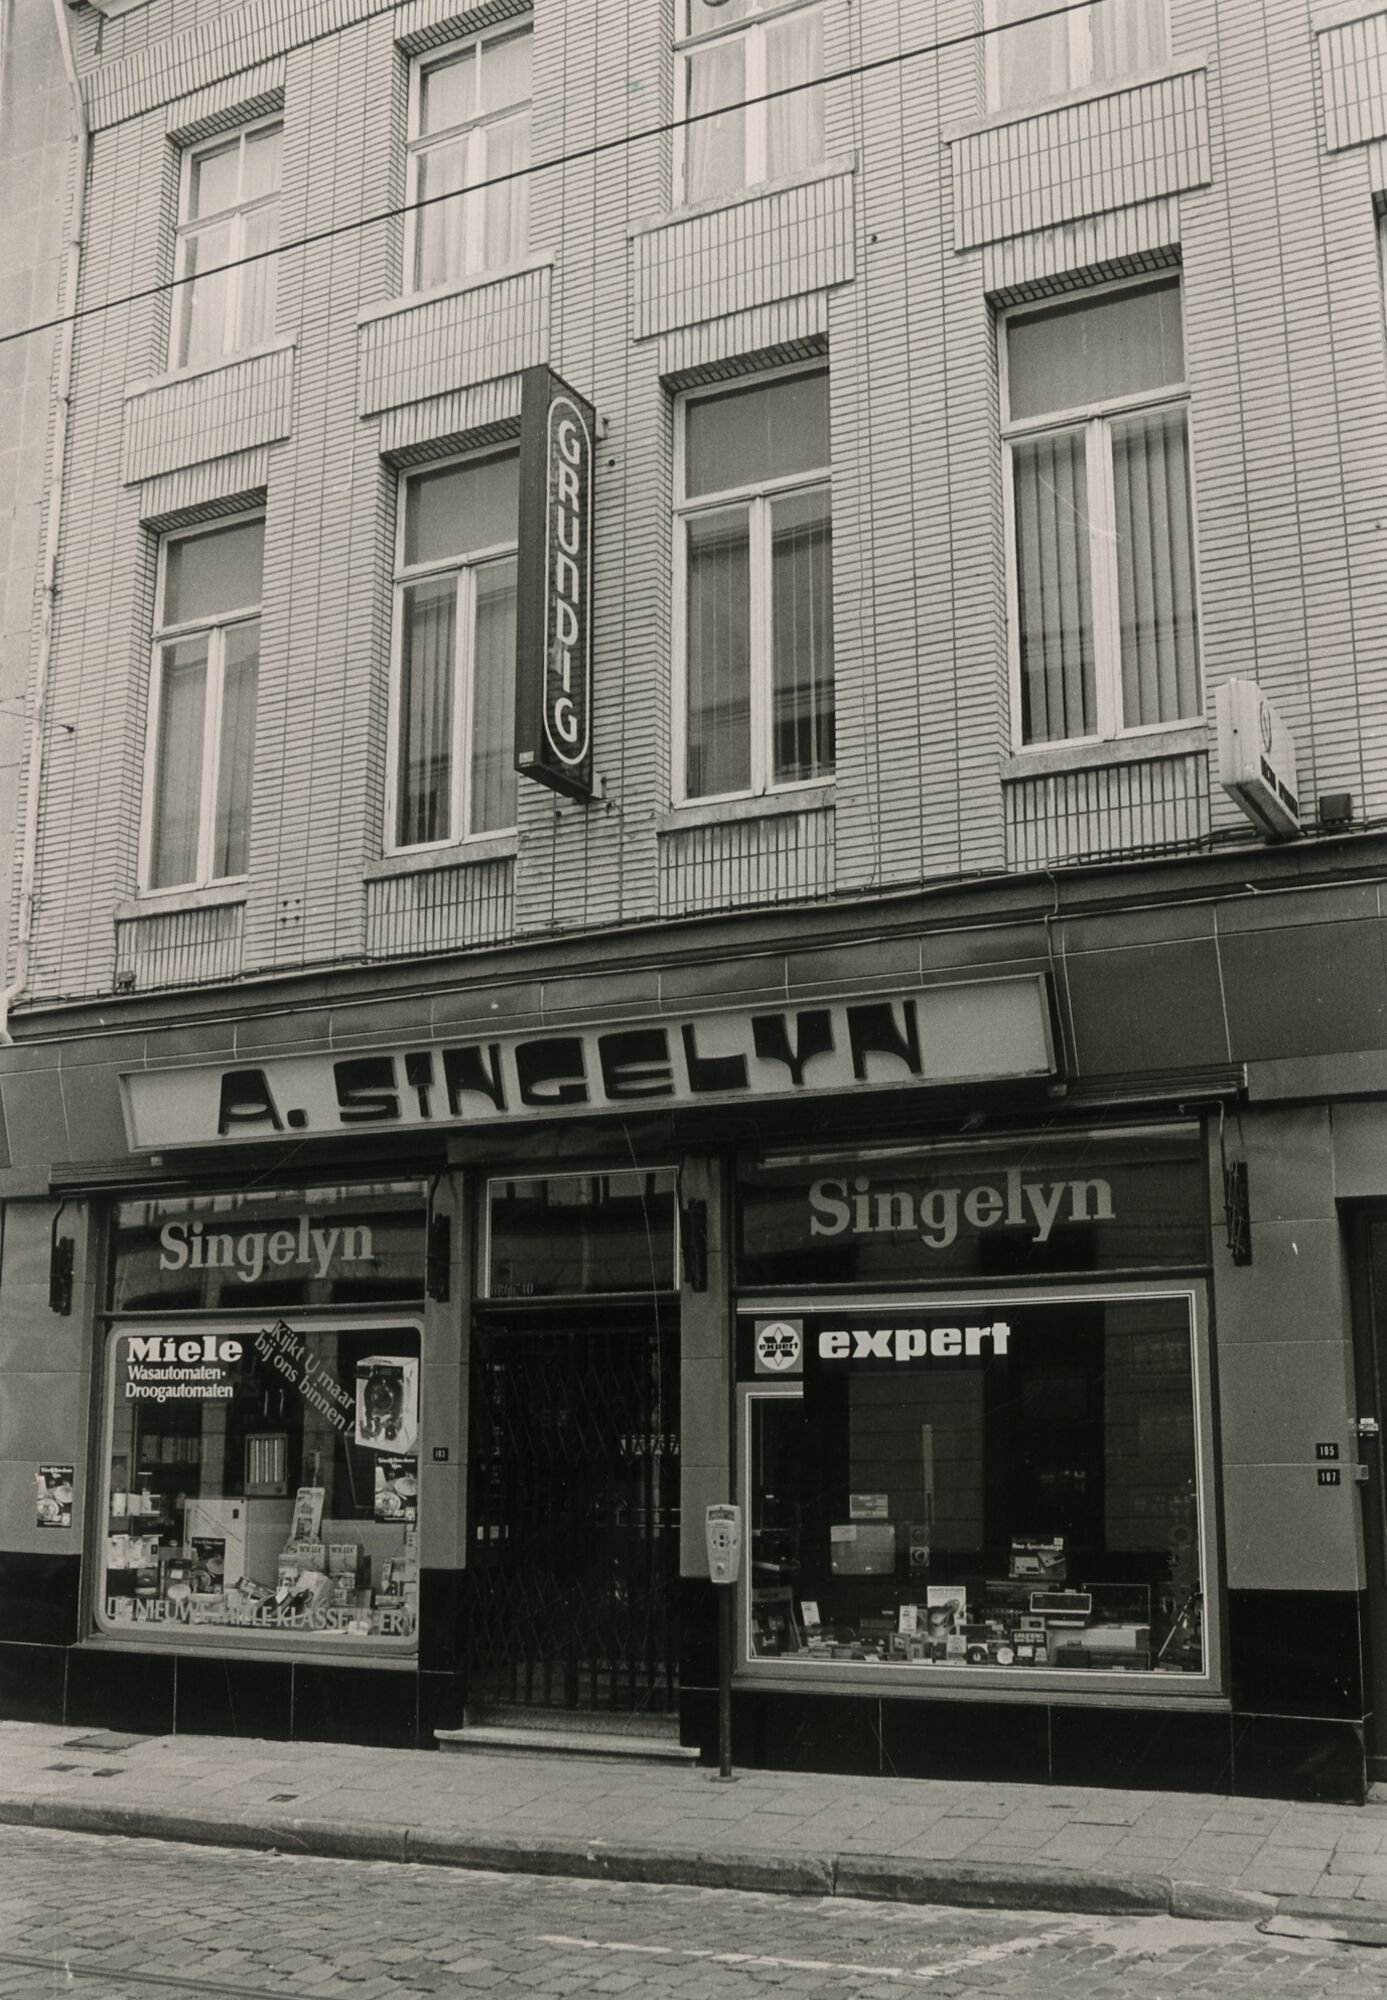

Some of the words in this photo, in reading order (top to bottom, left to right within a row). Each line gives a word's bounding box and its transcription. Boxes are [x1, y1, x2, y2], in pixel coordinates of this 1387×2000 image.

[554, 419, 581, 743] GRUNDIG
[217, 1068, 308, 1136] A.
[333, 1000, 923, 1123] SINGELYN
[808, 1168, 1116, 1248] Singelyn
[159, 1215, 375, 1283] Singelyn
[126, 1335, 243, 1363] Miele
[759, 1341, 799, 1350] expert
[818, 1321, 1011, 1362] expert
[254, 1332, 277, 1362] bij
[273, 1354, 299, 1383] ons
[298, 1375, 346, 1431] binnen
[271, 1321, 305, 1362] Kijkt
[304, 1353, 321, 1374] U
[317, 1371, 356, 1409] maar
[125, 1382, 234, 1403] Droogautomaten
[1319, 1445, 1335, 1456] 105
[1321, 1472, 1336, 1482] 107
[276, 1606, 349, 1630] KLASSE
[380, 1609, 402, 1632] ER
